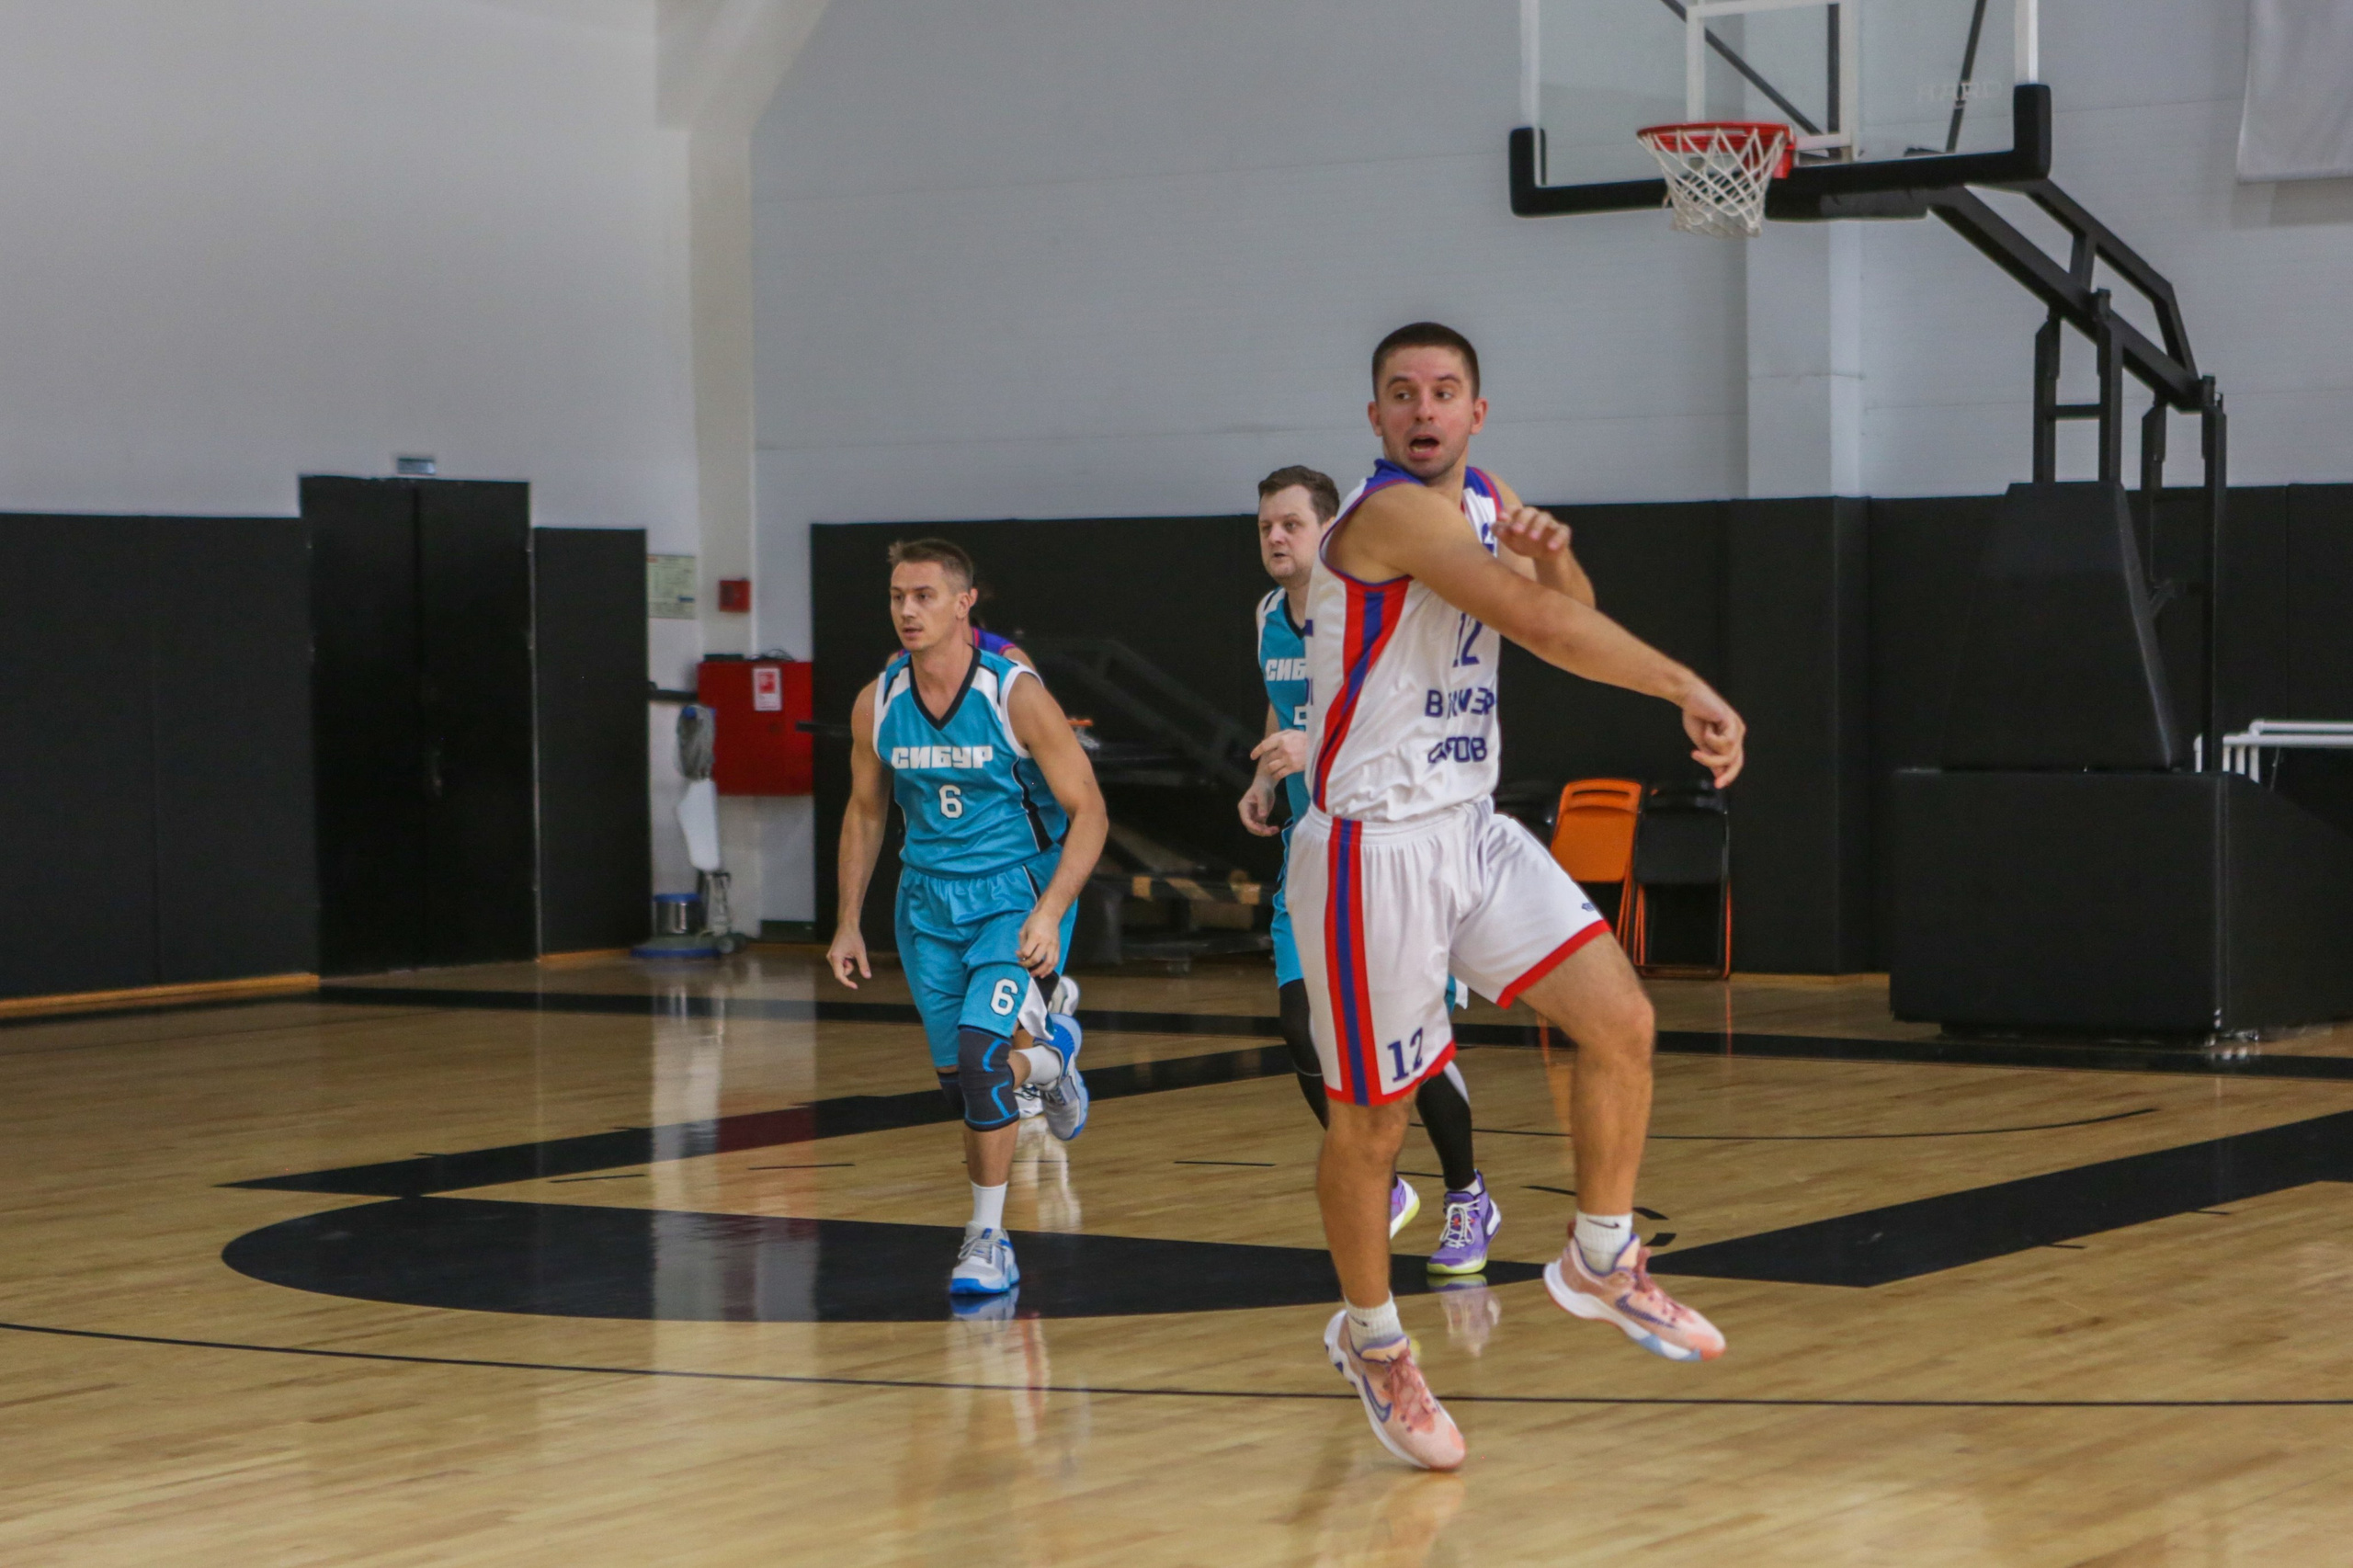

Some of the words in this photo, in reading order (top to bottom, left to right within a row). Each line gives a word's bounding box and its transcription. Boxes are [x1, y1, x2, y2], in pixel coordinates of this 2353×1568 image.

[1452, 612, 1483, 667] 12
[1265, 658, 1306, 681] СИБ
[891, 745, 994, 769] СИБУР
[938, 784, 963, 819] 6
[990, 978, 1020, 1016] 6
[1387, 1027, 1423, 1083] 12
